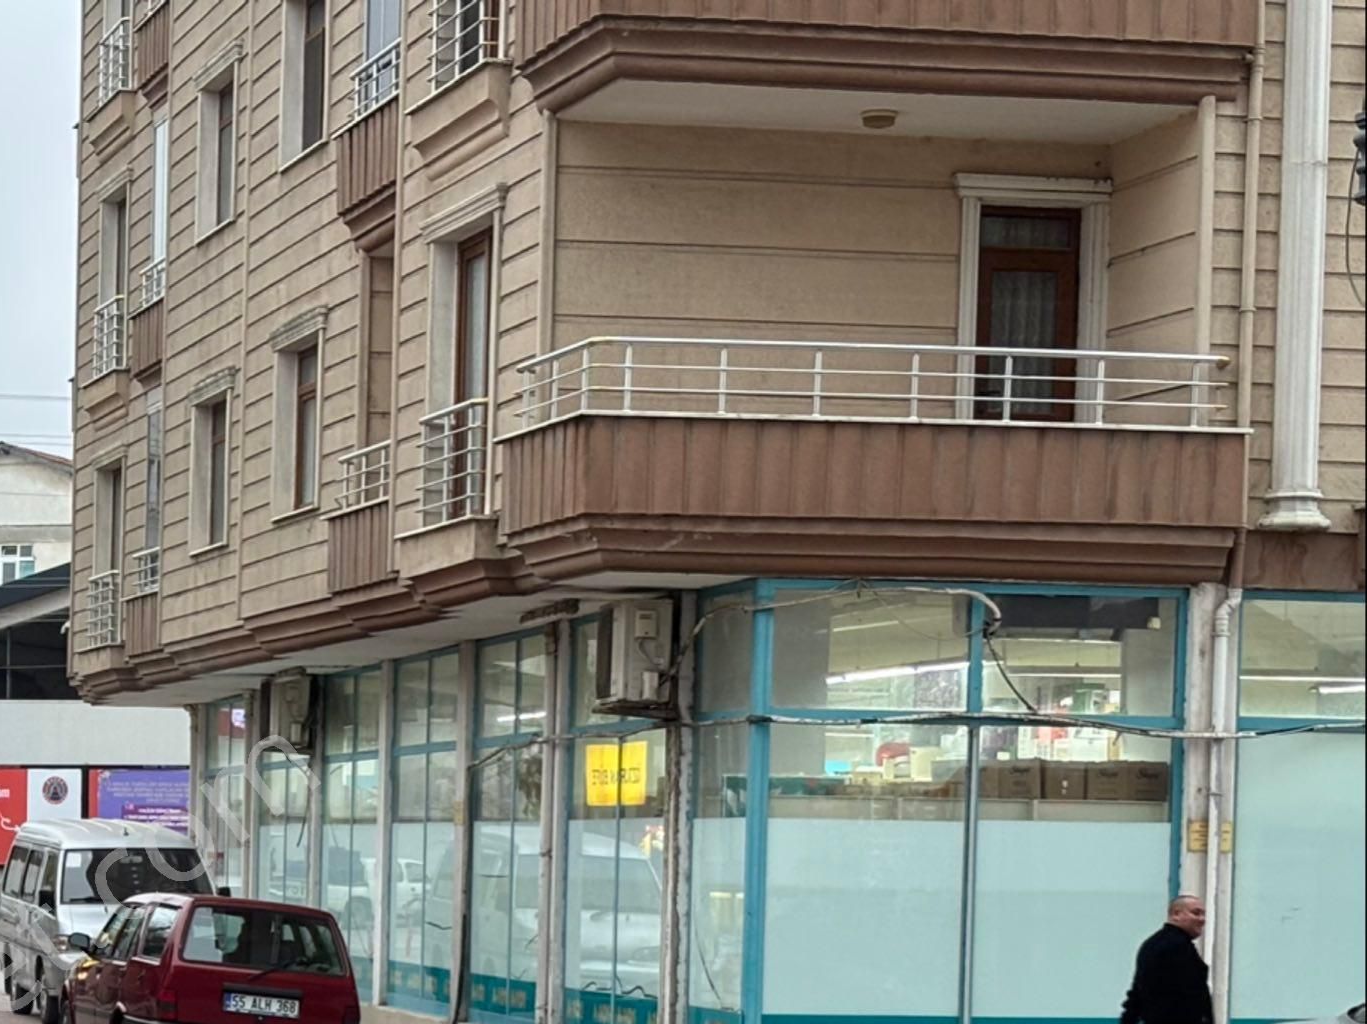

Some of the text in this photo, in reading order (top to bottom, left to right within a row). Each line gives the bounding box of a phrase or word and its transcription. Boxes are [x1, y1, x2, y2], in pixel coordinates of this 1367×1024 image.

[232, 995, 297, 1013] 55 ALH 368
